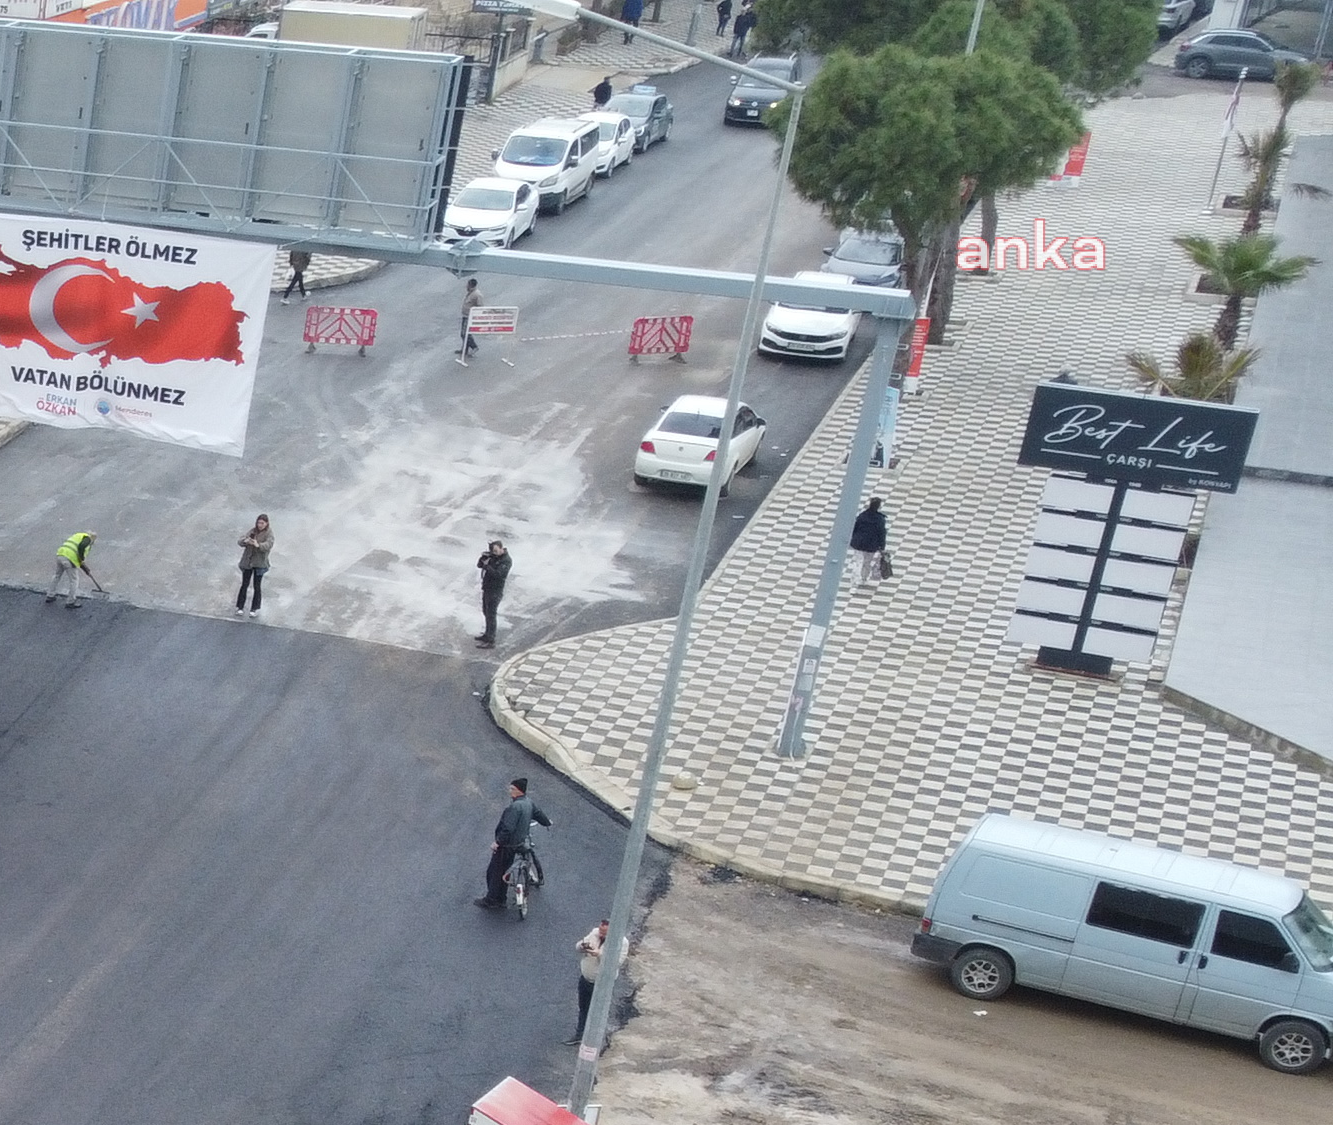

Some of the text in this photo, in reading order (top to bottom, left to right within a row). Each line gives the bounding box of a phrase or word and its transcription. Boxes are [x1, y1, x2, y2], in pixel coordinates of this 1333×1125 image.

[22, 229, 198, 265] ŞEHİTLER ÖLMEZ
[11, 366, 186, 406] VATAN BÖLÜNMEZ
[36, 399, 76, 416] ÖZKAN
[46, 393, 77, 405] ERKAN
[1044, 404, 1228, 459] Best Life
[1106, 453, 1152, 469] ÇARŞI
[1188, 477, 1197, 486] by
